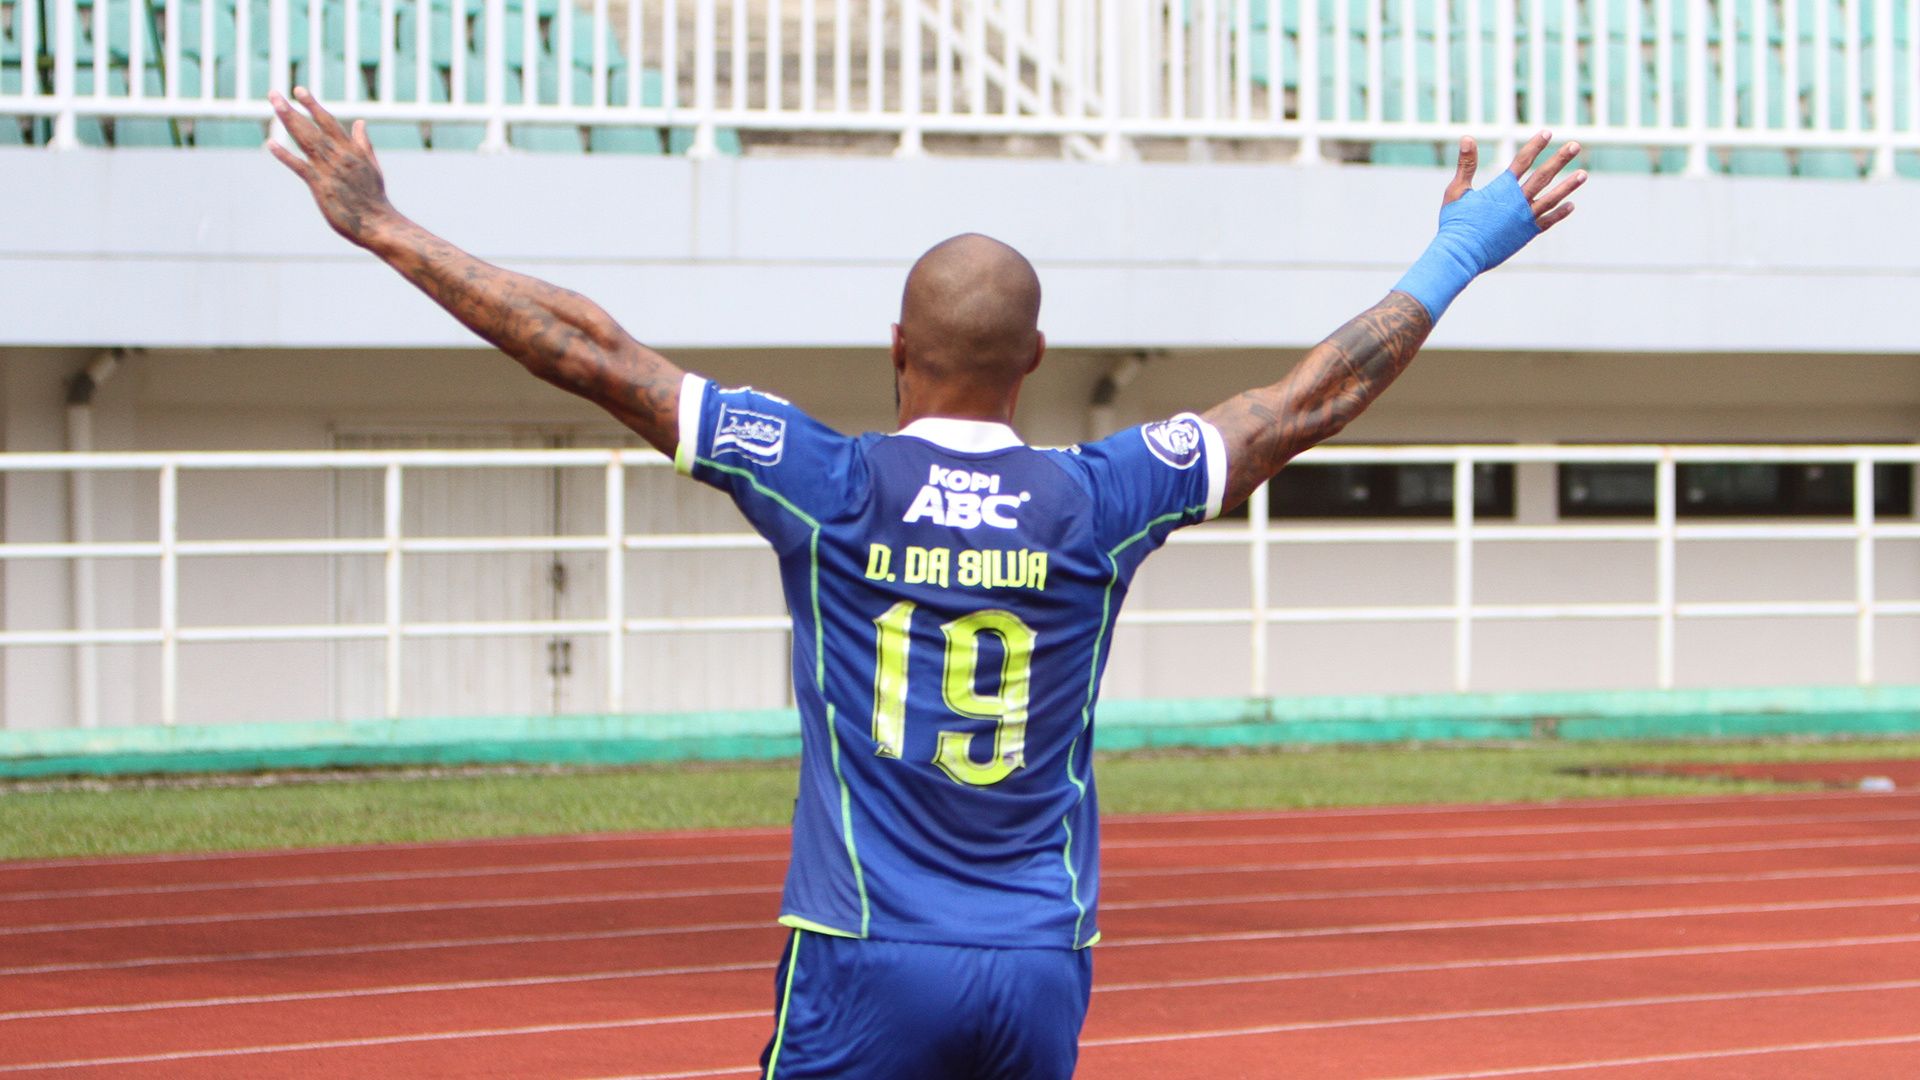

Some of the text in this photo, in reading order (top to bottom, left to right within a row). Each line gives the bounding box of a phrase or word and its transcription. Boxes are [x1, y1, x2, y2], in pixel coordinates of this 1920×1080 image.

[929, 464, 1000, 494] KOPI
[902, 485, 1020, 529] ABC
[865, 543, 1048, 591] D. DA SILVA
[872, 600, 1037, 786] 19
